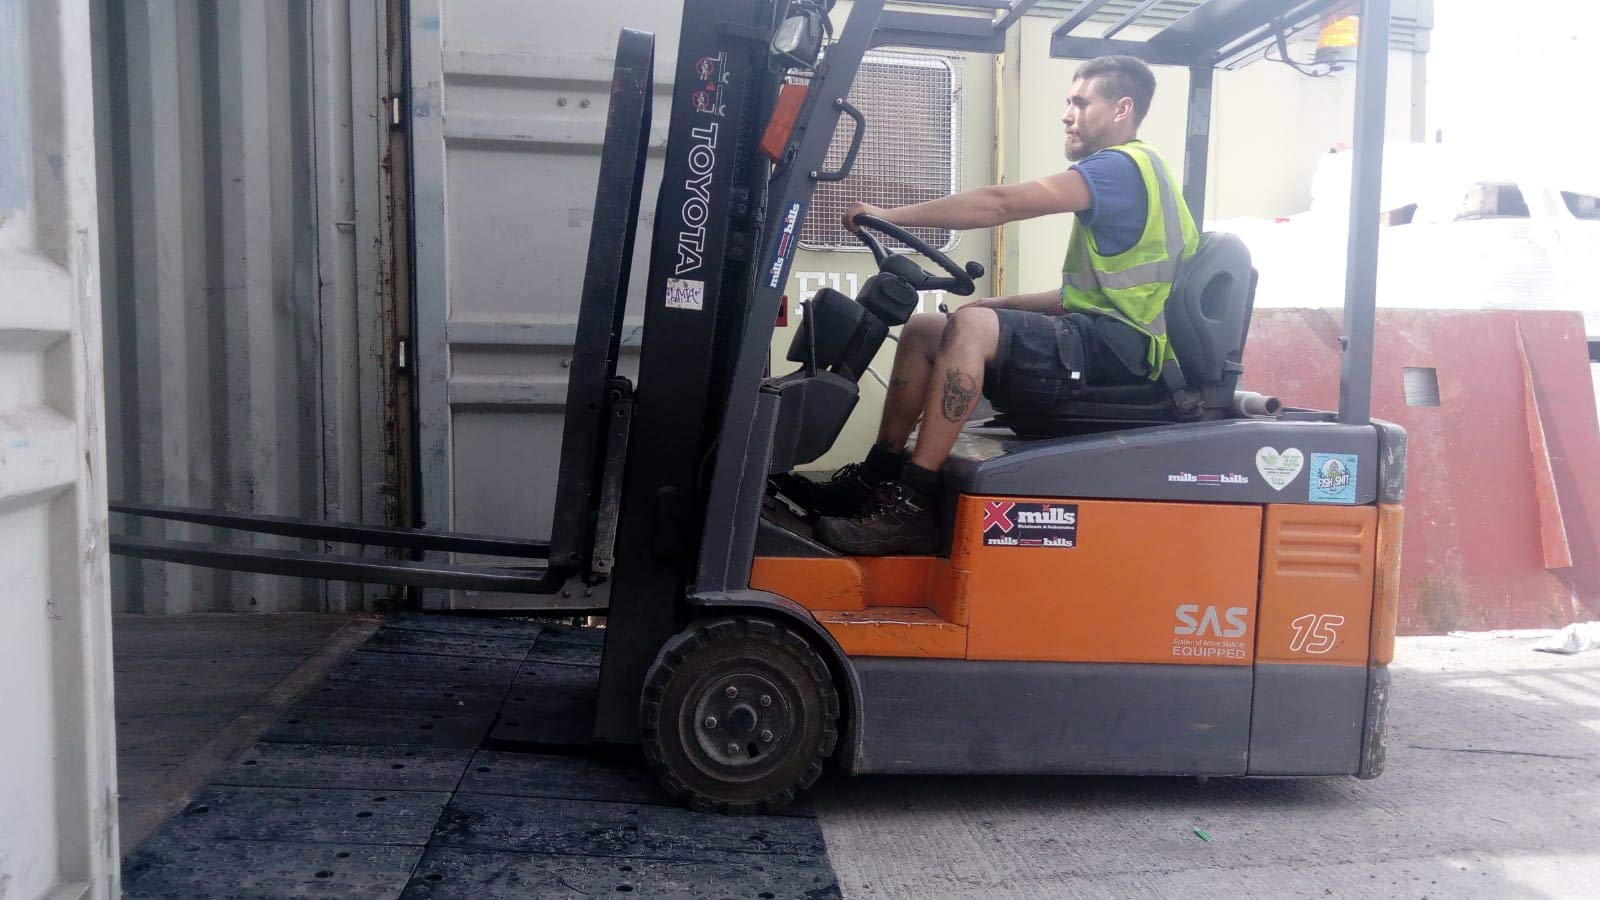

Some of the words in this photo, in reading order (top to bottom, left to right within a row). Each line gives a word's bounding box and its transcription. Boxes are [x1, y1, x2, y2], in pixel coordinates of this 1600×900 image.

[675, 123, 718, 276] TOYOTA
[1018, 504, 1076, 525] mills
[1174, 604, 1248, 638] SAS
[1289, 613, 1345, 654] 15
[1172, 646, 1246, 659] EQUIPPED
[1173, 638, 1195, 646] System
